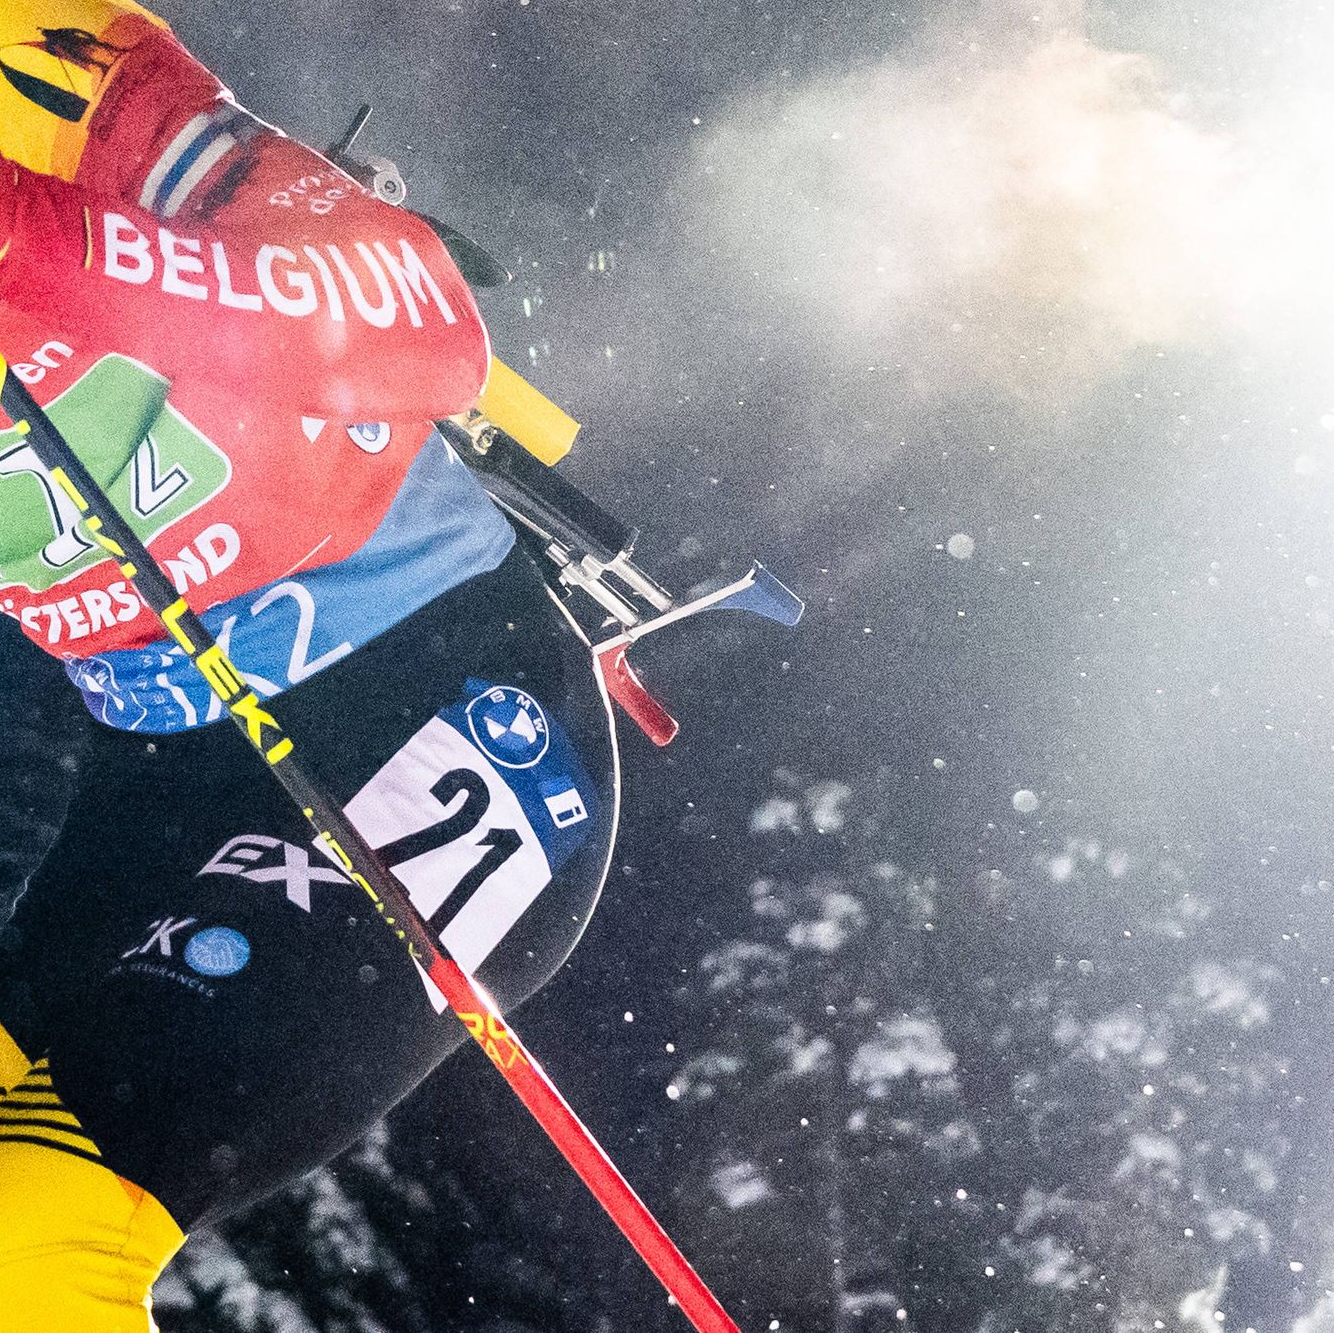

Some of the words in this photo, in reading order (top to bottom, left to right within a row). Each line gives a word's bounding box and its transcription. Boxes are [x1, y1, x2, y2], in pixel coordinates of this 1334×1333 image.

[103, 211, 457, 329] BELGIUM
[161, 598, 295, 765] LEKI
[369, 767, 525, 936] 21
